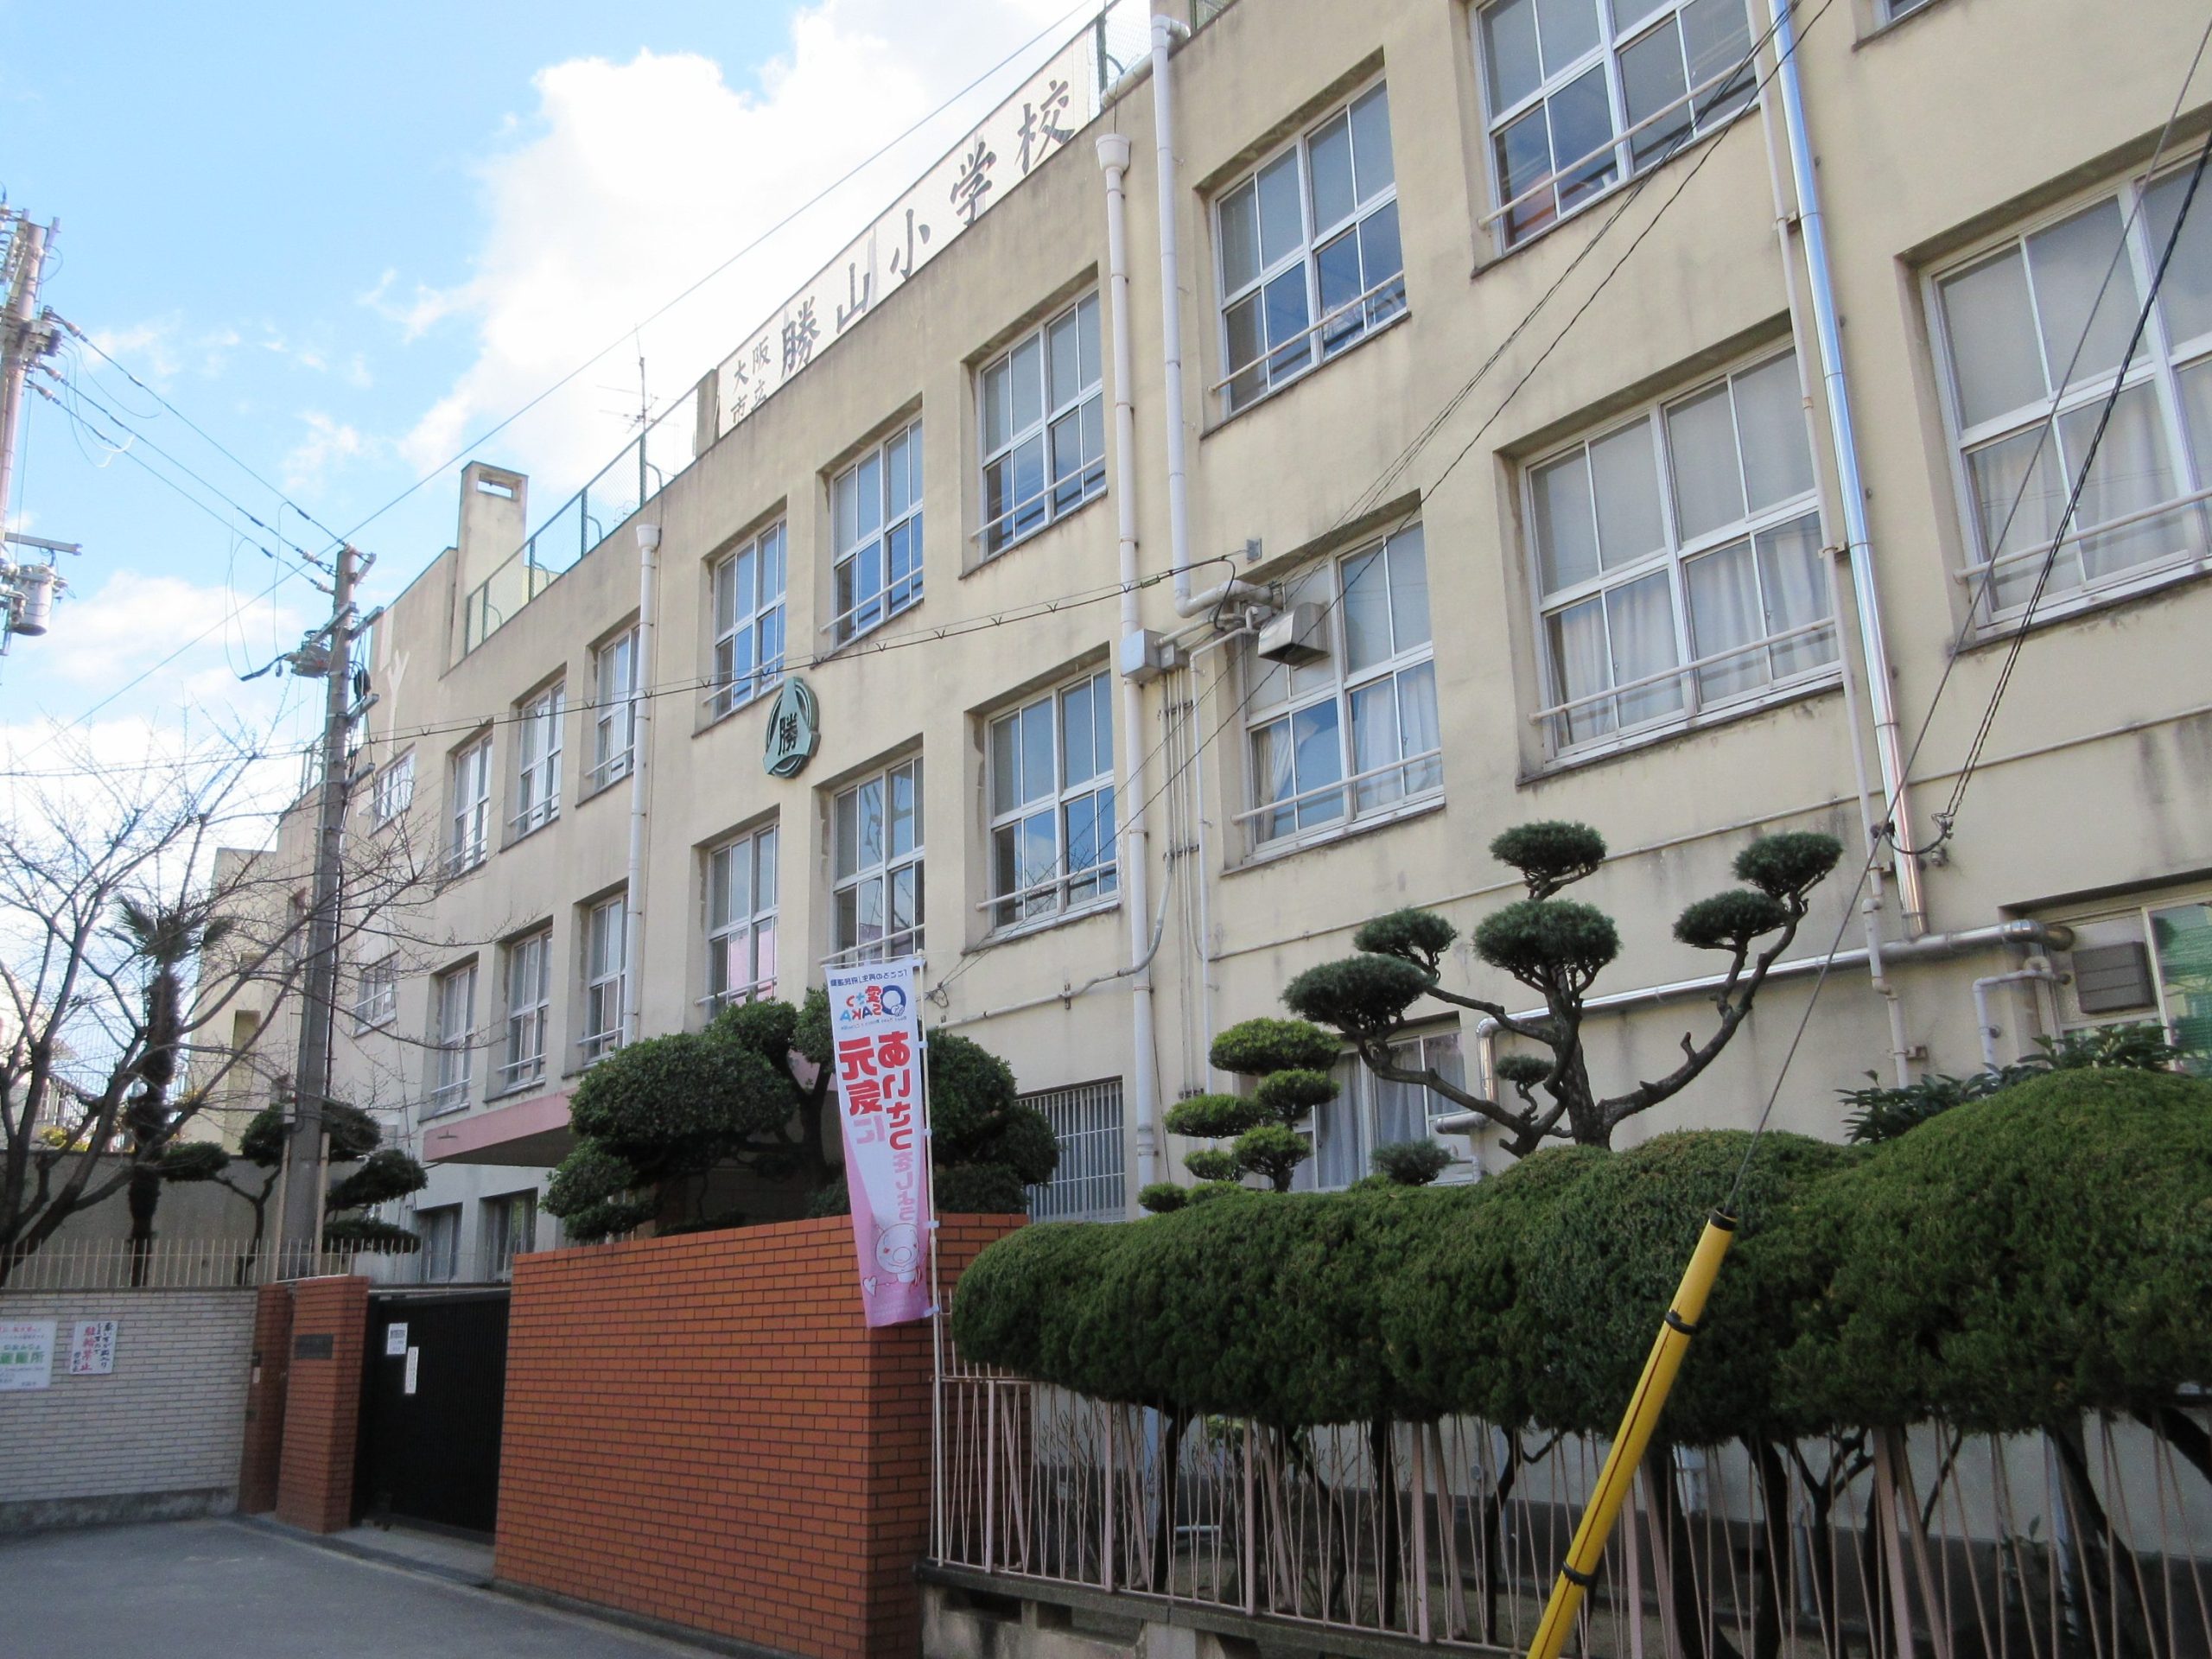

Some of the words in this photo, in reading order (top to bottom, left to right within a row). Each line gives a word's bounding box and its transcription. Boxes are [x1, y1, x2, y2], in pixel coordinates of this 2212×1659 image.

[779, 79, 1074, 378] 勝山小学校
[733, 336, 769, 394] 大阪
[730, 380, 767, 424] 市立
[778, 712, 798, 756] 勝
